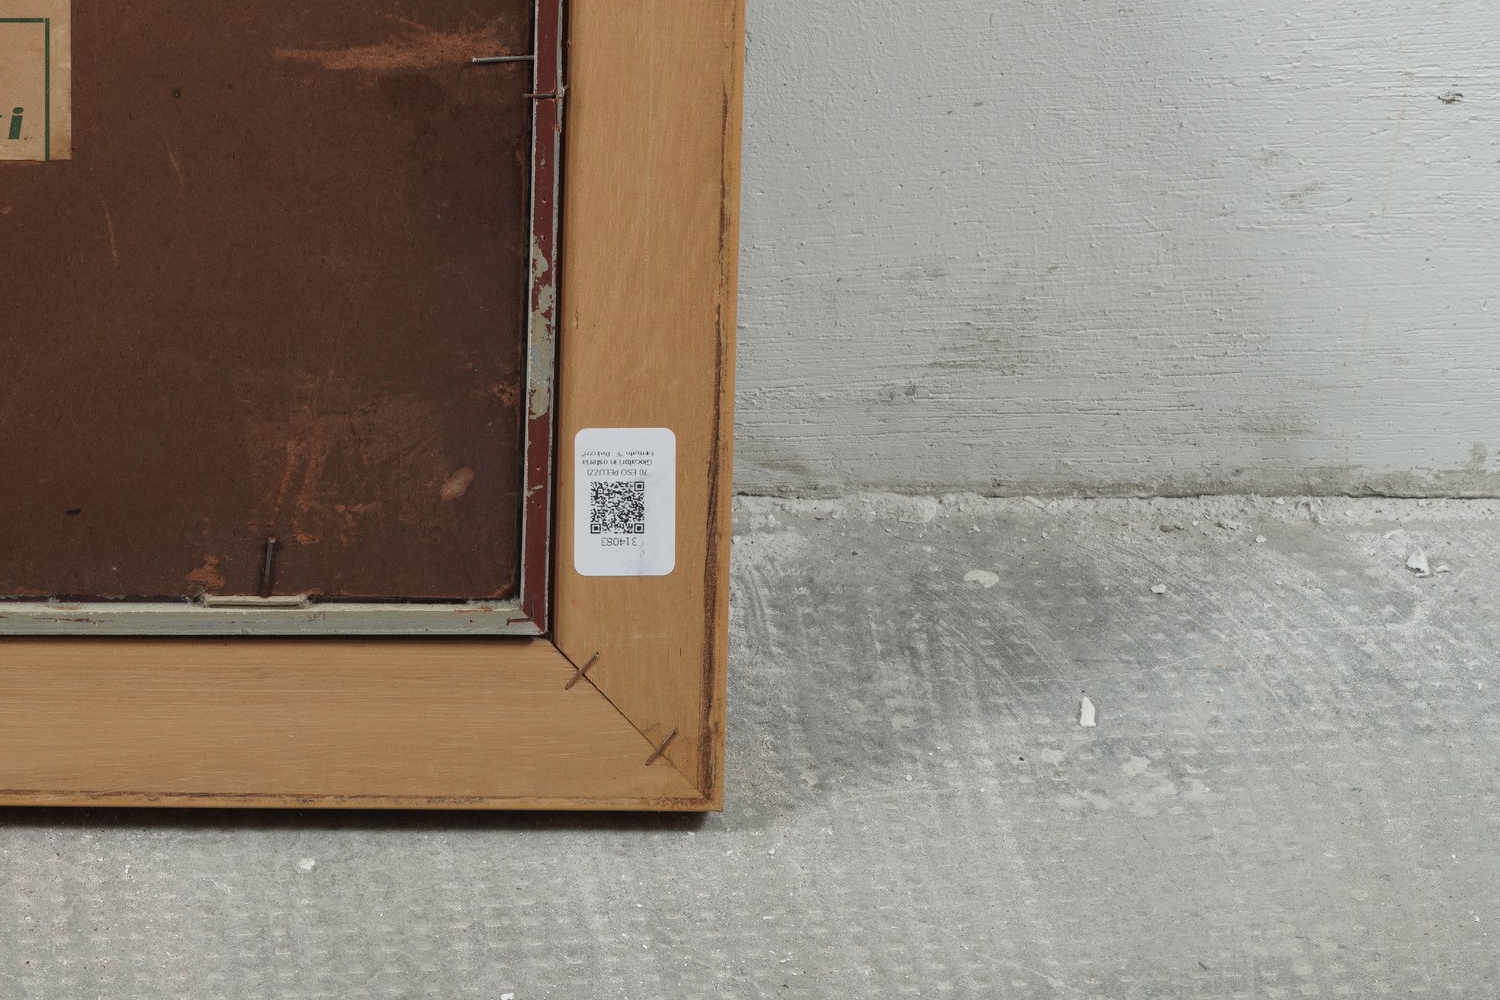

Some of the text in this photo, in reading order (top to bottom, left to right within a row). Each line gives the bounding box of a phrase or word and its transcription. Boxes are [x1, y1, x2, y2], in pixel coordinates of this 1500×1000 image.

[619, 459, 653, 467] Giocatori
[586, 468, 619, 476] PELUZZI
[620, 468, 637, 476] ESO
[600, 537, 638, 547] 314083
